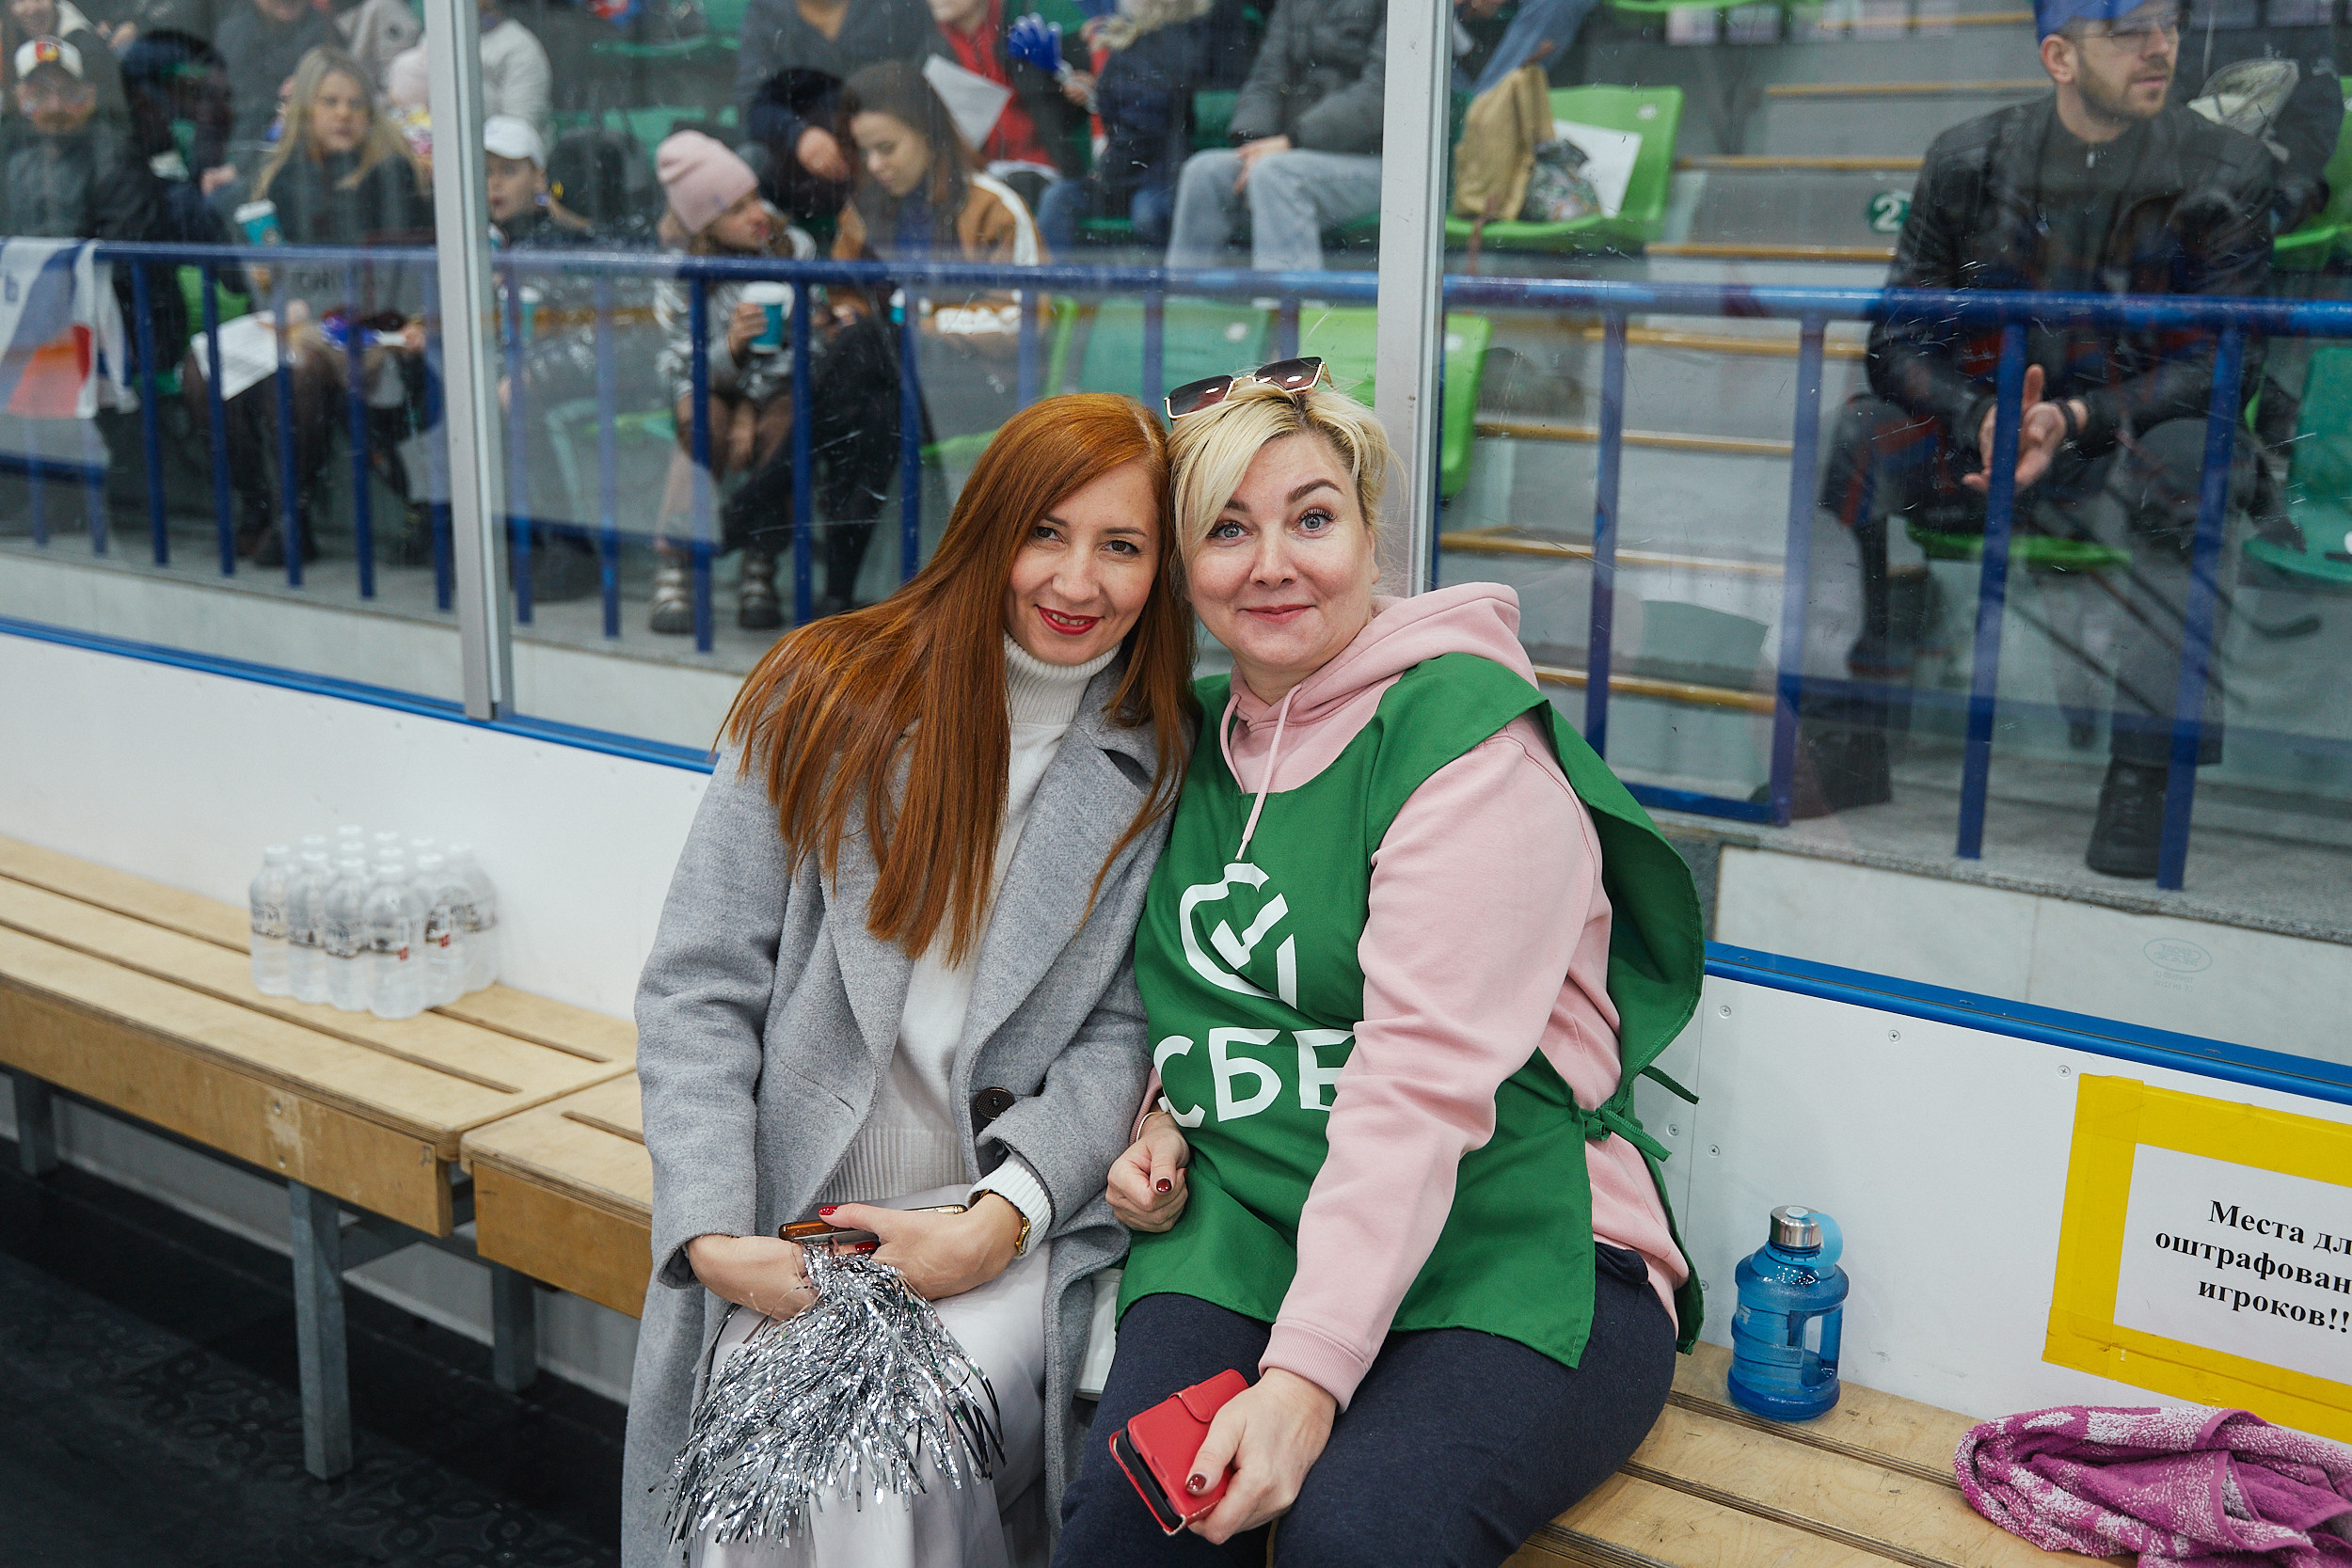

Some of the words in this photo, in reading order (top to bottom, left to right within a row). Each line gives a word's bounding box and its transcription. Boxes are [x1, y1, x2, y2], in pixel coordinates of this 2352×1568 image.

[1872, 194, 1901, 233] 2
[2208, 1199, 2305, 1244] Места
[2155, 1232, 2352, 1295] оштрафован
[2198, 1280, 2350, 1334] игроков!!
